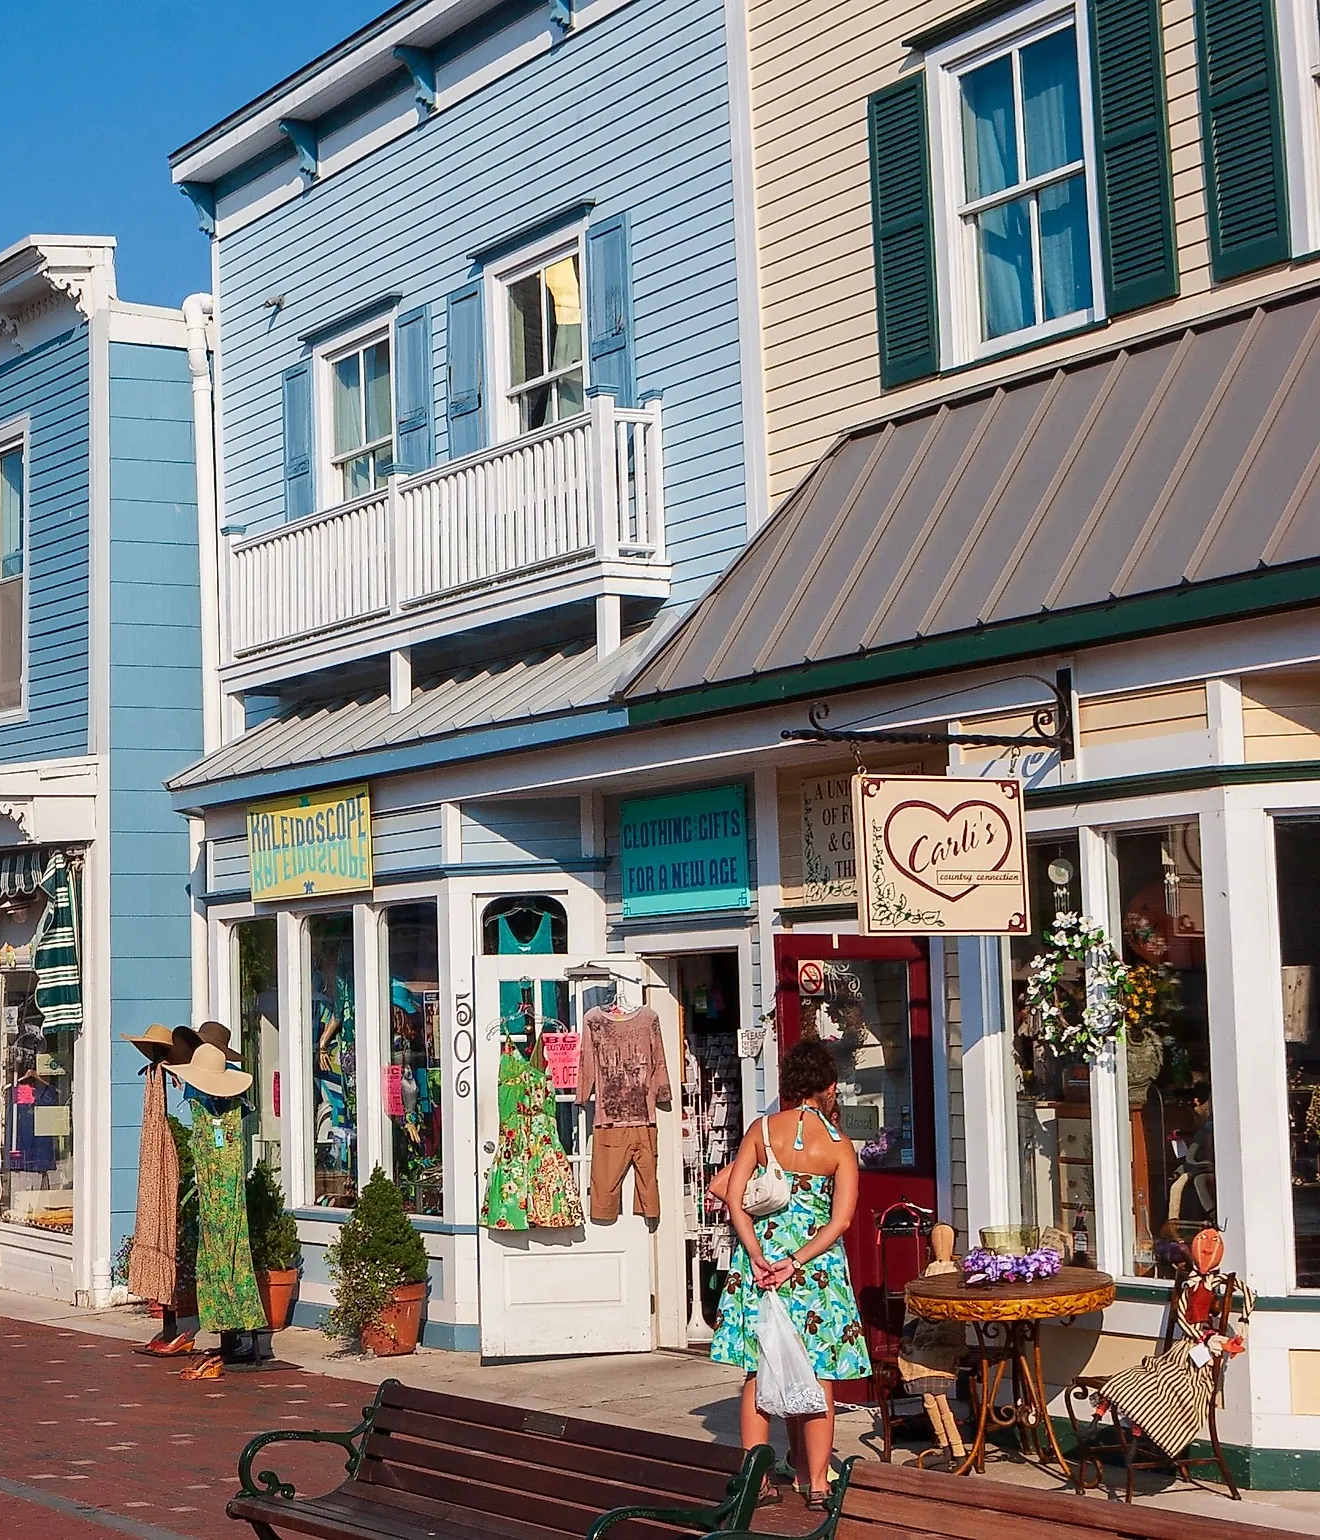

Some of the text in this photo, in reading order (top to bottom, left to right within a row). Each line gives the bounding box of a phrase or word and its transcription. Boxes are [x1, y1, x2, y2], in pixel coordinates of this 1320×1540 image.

[250, 793, 367, 853] KALEIDOSCOPE
[623, 808, 741, 850] CLOTHING GIFTS
[822, 808, 838, 826] OF
[908, 810, 998, 873] Carli's
[628, 856, 738, 893] FOR A NEW AGE
[939, 872, 1020, 883] country connection
[453, 992, 474, 1099] 506
[562, 1065, 578, 1085] OFF
